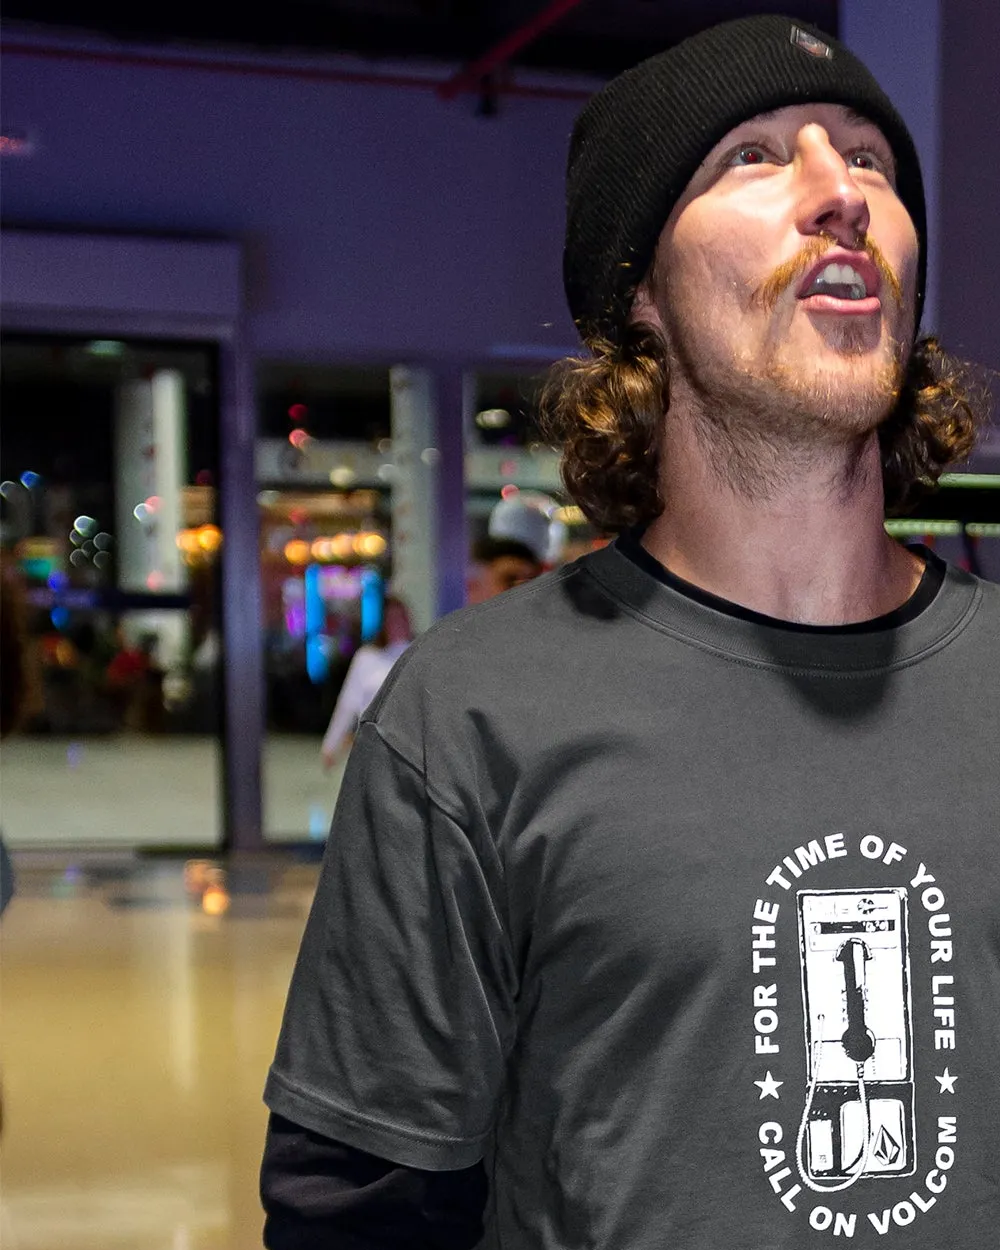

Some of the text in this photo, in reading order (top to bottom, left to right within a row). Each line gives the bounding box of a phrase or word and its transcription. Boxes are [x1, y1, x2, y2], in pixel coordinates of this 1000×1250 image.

[752, 833, 956, 1055] FOR THE TIME OF YOUR LIFE
[759, 1117, 957, 1238] CALL ON VOLCOM
